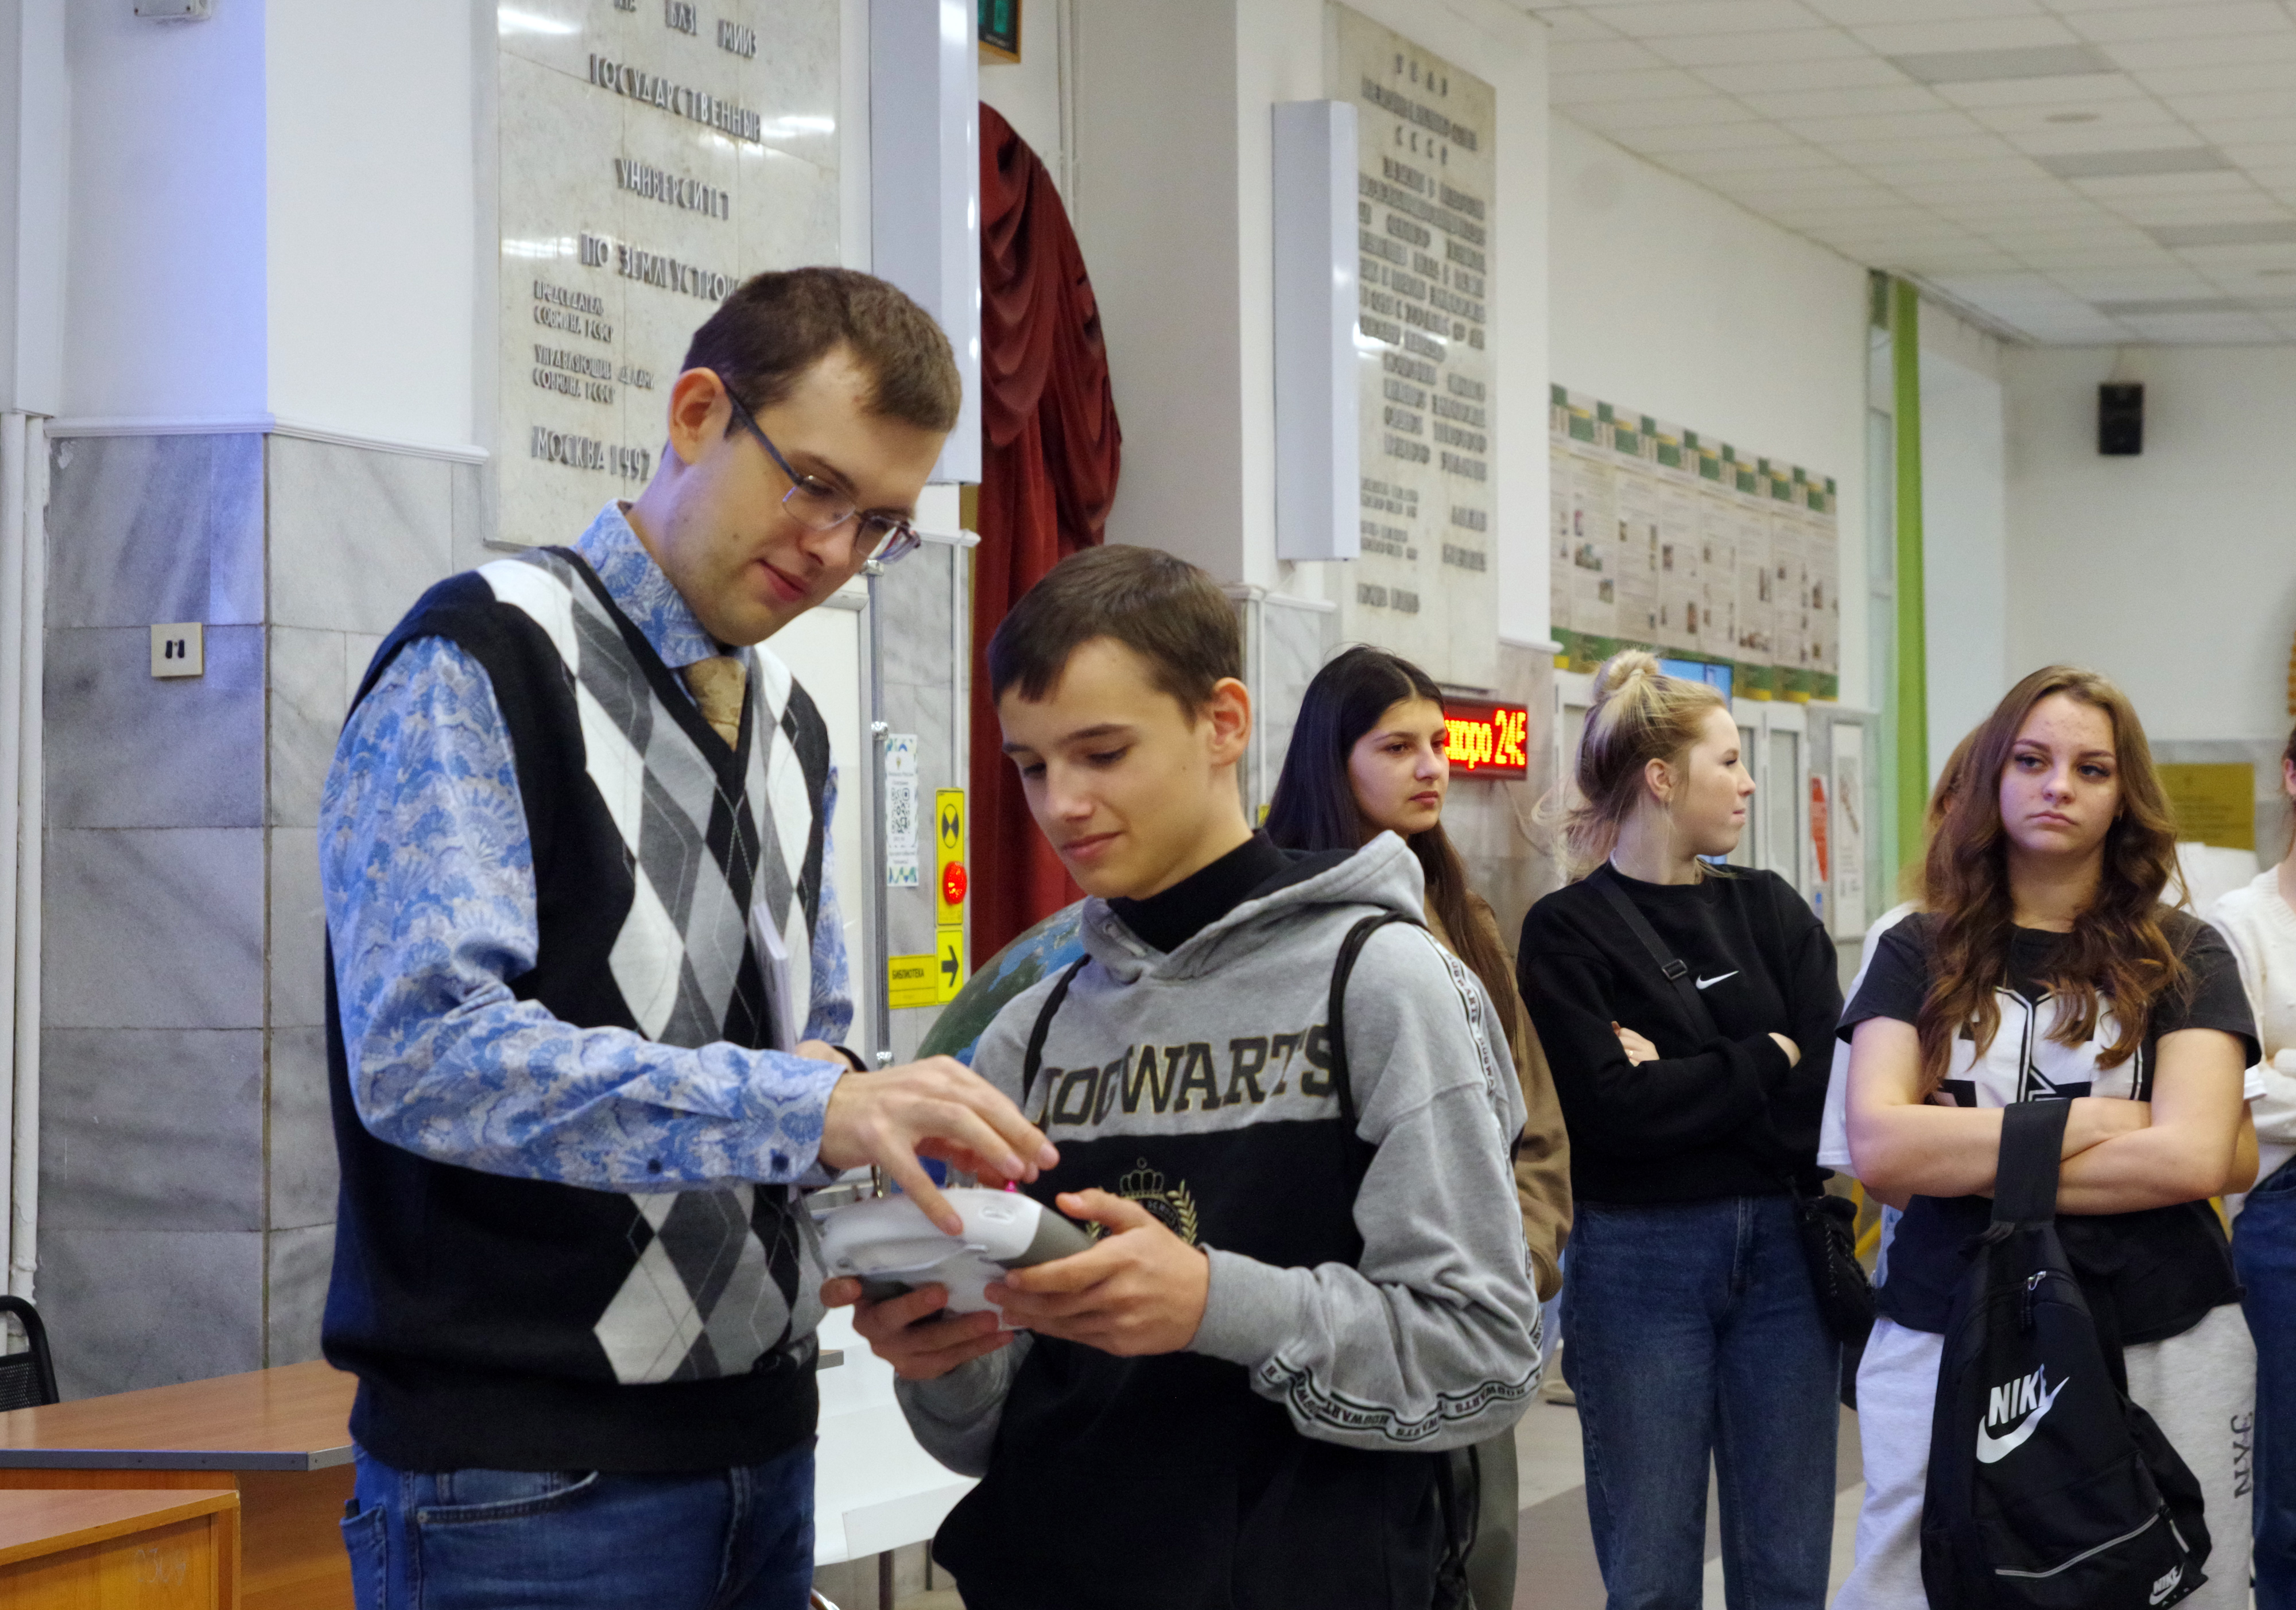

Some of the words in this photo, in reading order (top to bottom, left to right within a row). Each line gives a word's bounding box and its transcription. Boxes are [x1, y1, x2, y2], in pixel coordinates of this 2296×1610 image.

[615, 157, 730, 220] УНИВЕРСИТЕТ
[581, 231, 611, 268] ПО
[532, 426, 604, 470] МОСКВА
